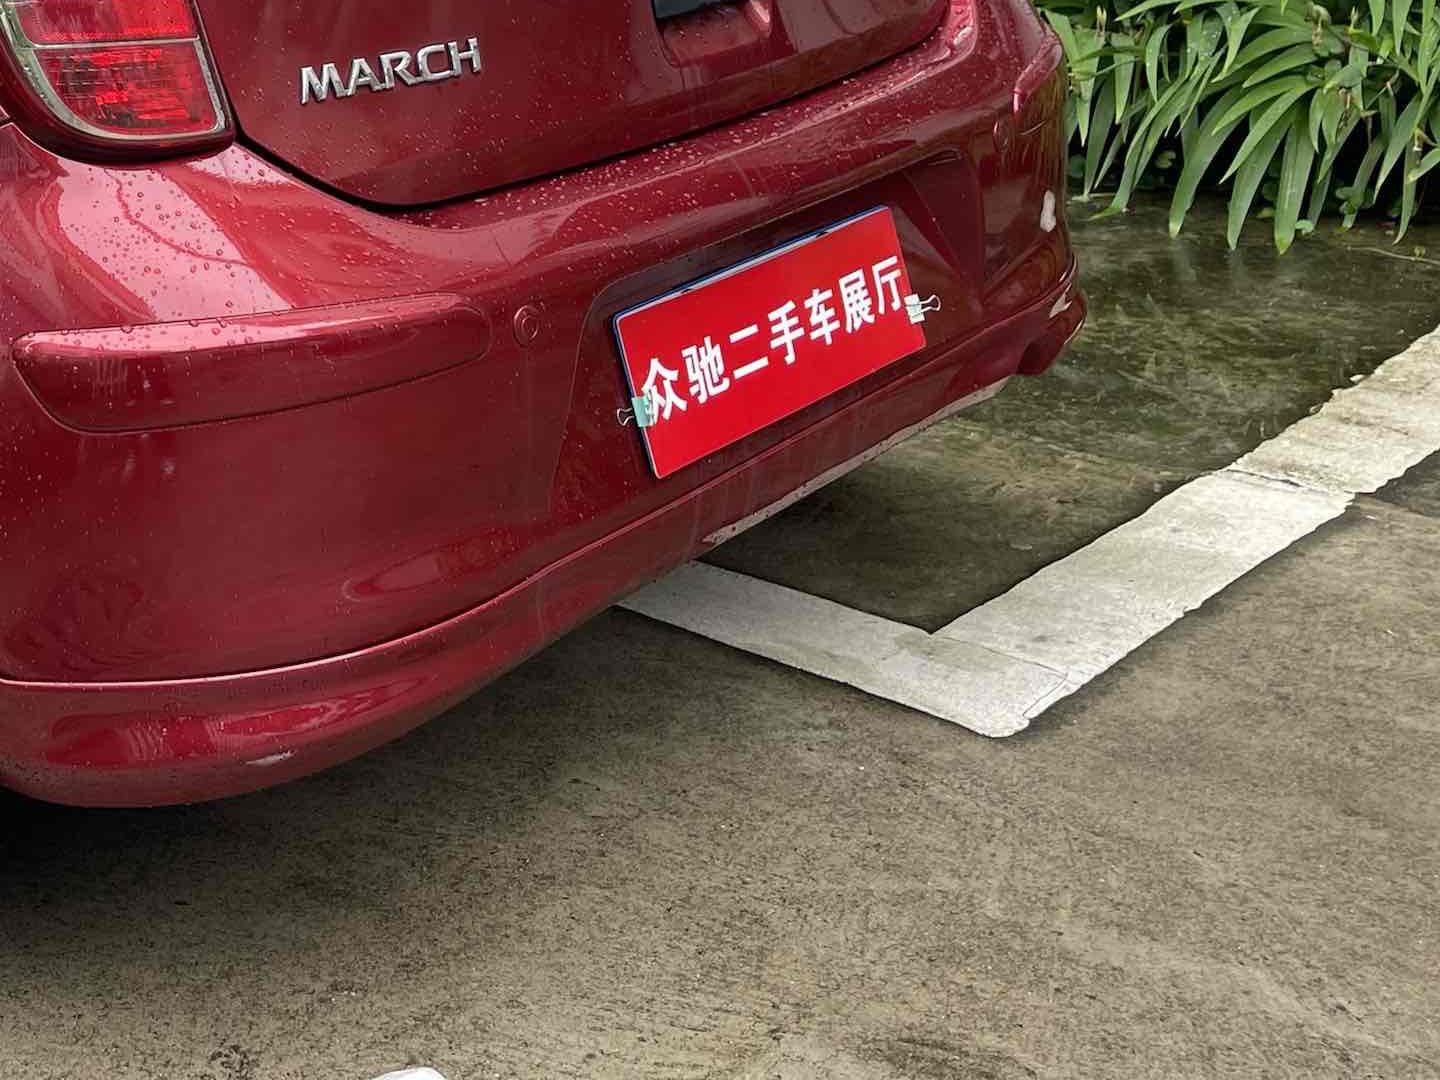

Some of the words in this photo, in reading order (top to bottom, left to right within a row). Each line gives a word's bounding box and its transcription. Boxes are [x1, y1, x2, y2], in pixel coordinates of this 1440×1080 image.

[300, 37, 481, 104] MARCH
[642, 256, 902, 424] 众驰二手车展厅
